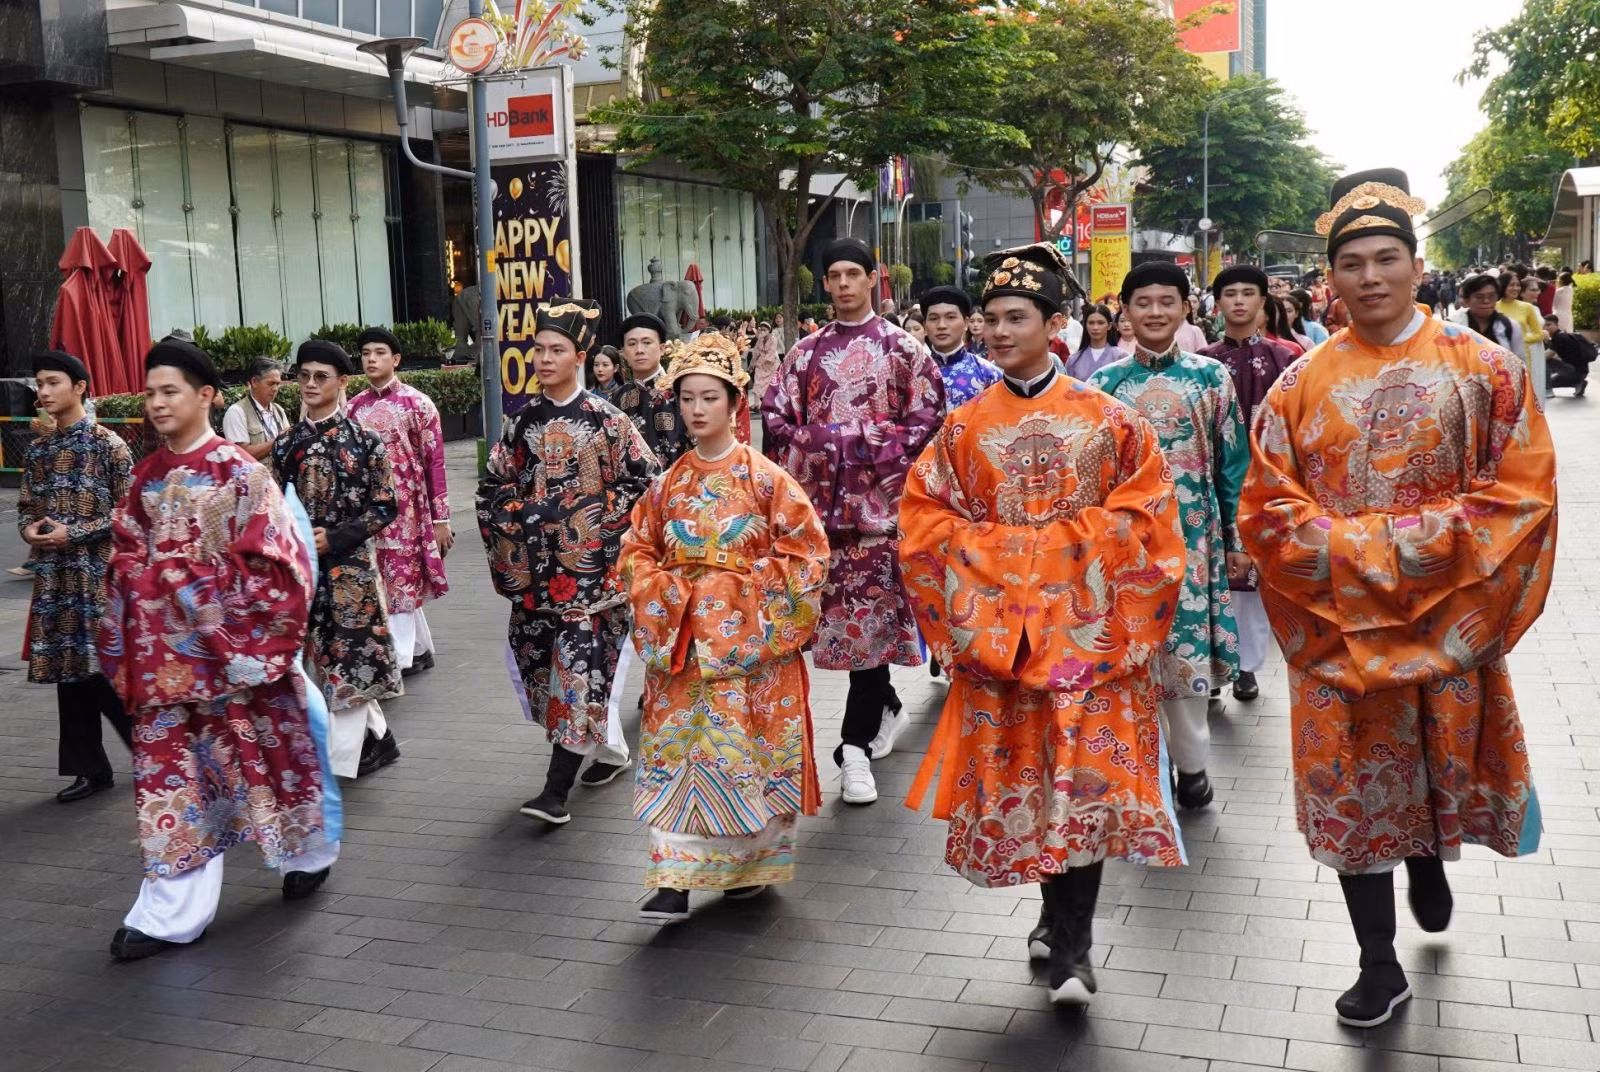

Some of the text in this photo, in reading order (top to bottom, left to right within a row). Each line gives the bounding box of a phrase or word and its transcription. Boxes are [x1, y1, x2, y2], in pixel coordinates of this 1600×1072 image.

[487, 109, 549, 128] HDBank
[495, 216, 560, 258] APPY
[496, 260, 547, 300] NEW
[497, 302, 546, 341] YEA
